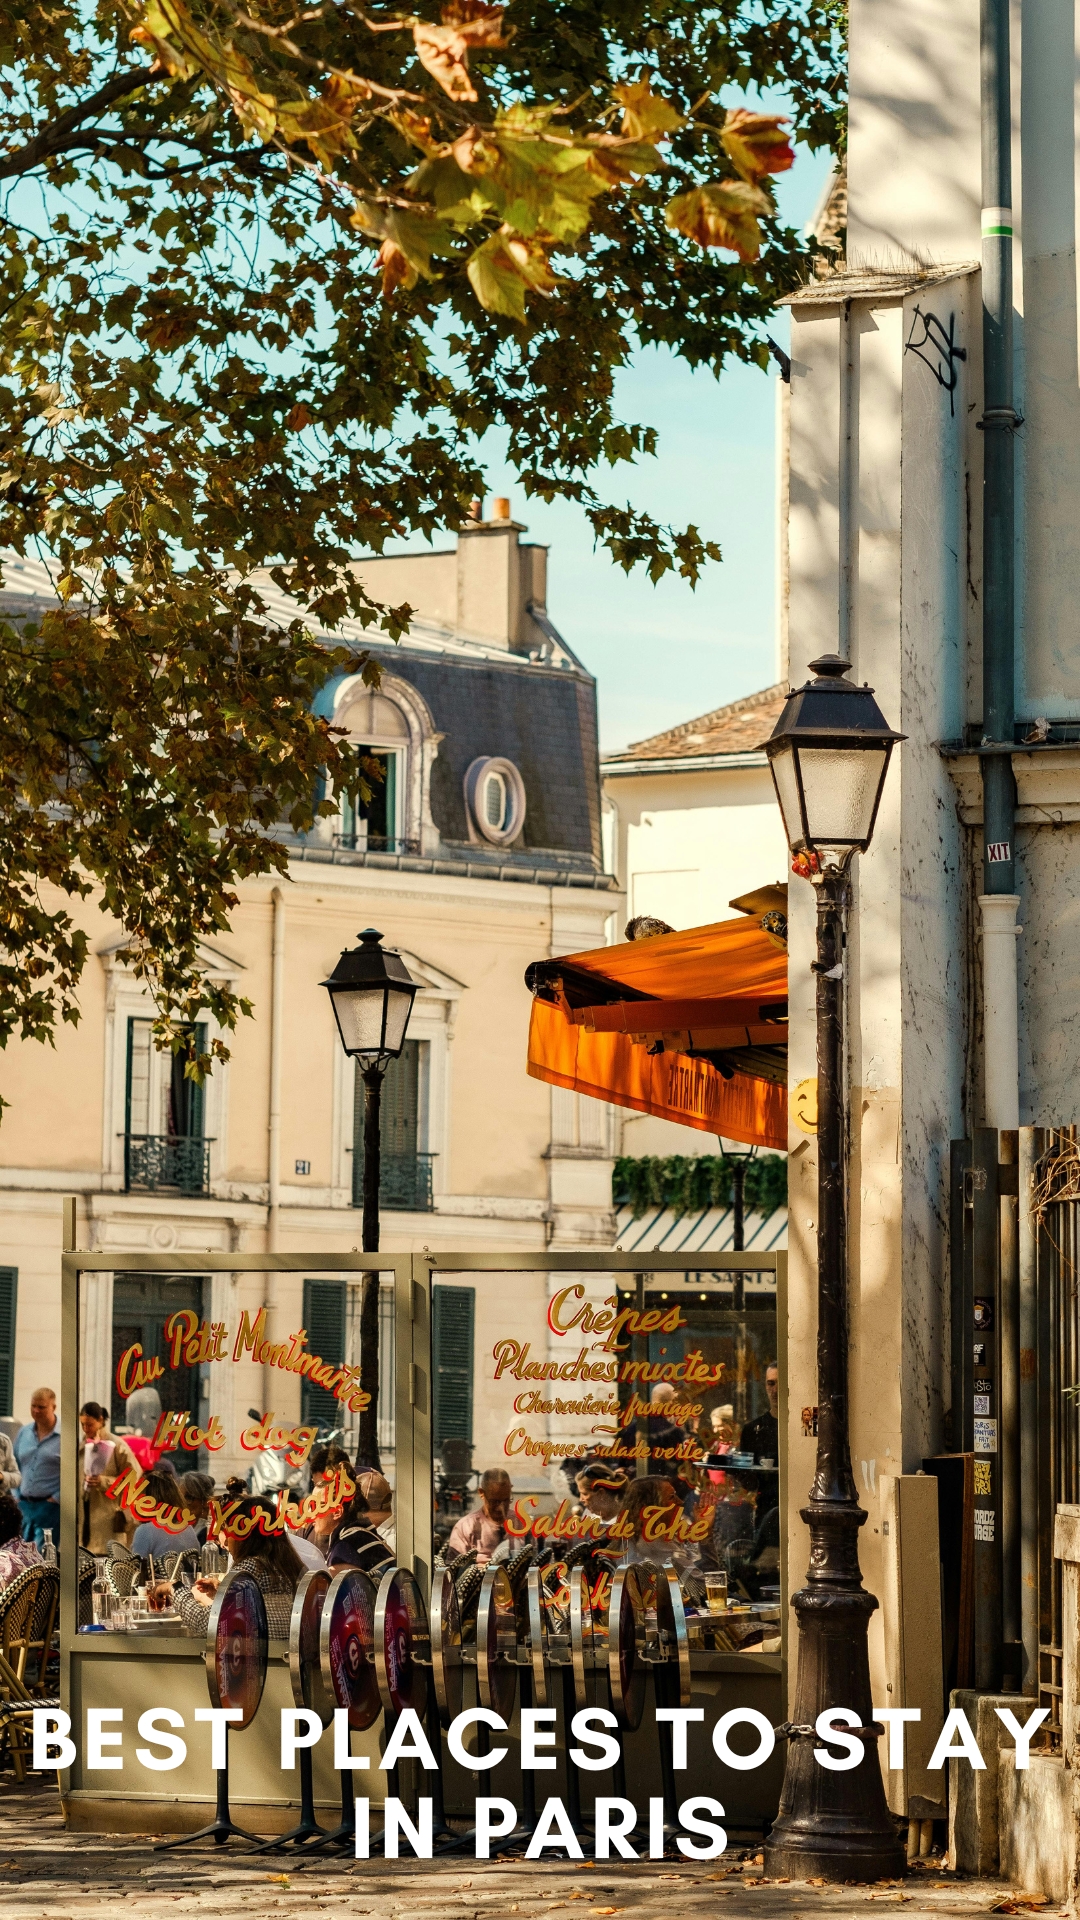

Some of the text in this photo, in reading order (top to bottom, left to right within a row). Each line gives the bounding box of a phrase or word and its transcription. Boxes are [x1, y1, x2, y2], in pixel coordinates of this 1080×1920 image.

[547, 1284, 687, 1352] Crêpes
[164, 1309, 229, 1368] Petit
[233, 1307, 372, 1413] Montmartre
[493, 1339, 619, 1382] Planches
[617, 1348, 725, 1385] mixtes
[621, 1392, 704, 1428] fromage
[150, 1411, 318, 1466] Hot dog
[504, 1427, 706, 1467] Croques salade verte
[105, 1460, 357, 1540] New Yorkais
[504, 1495, 715, 1543] Salon de Thé
